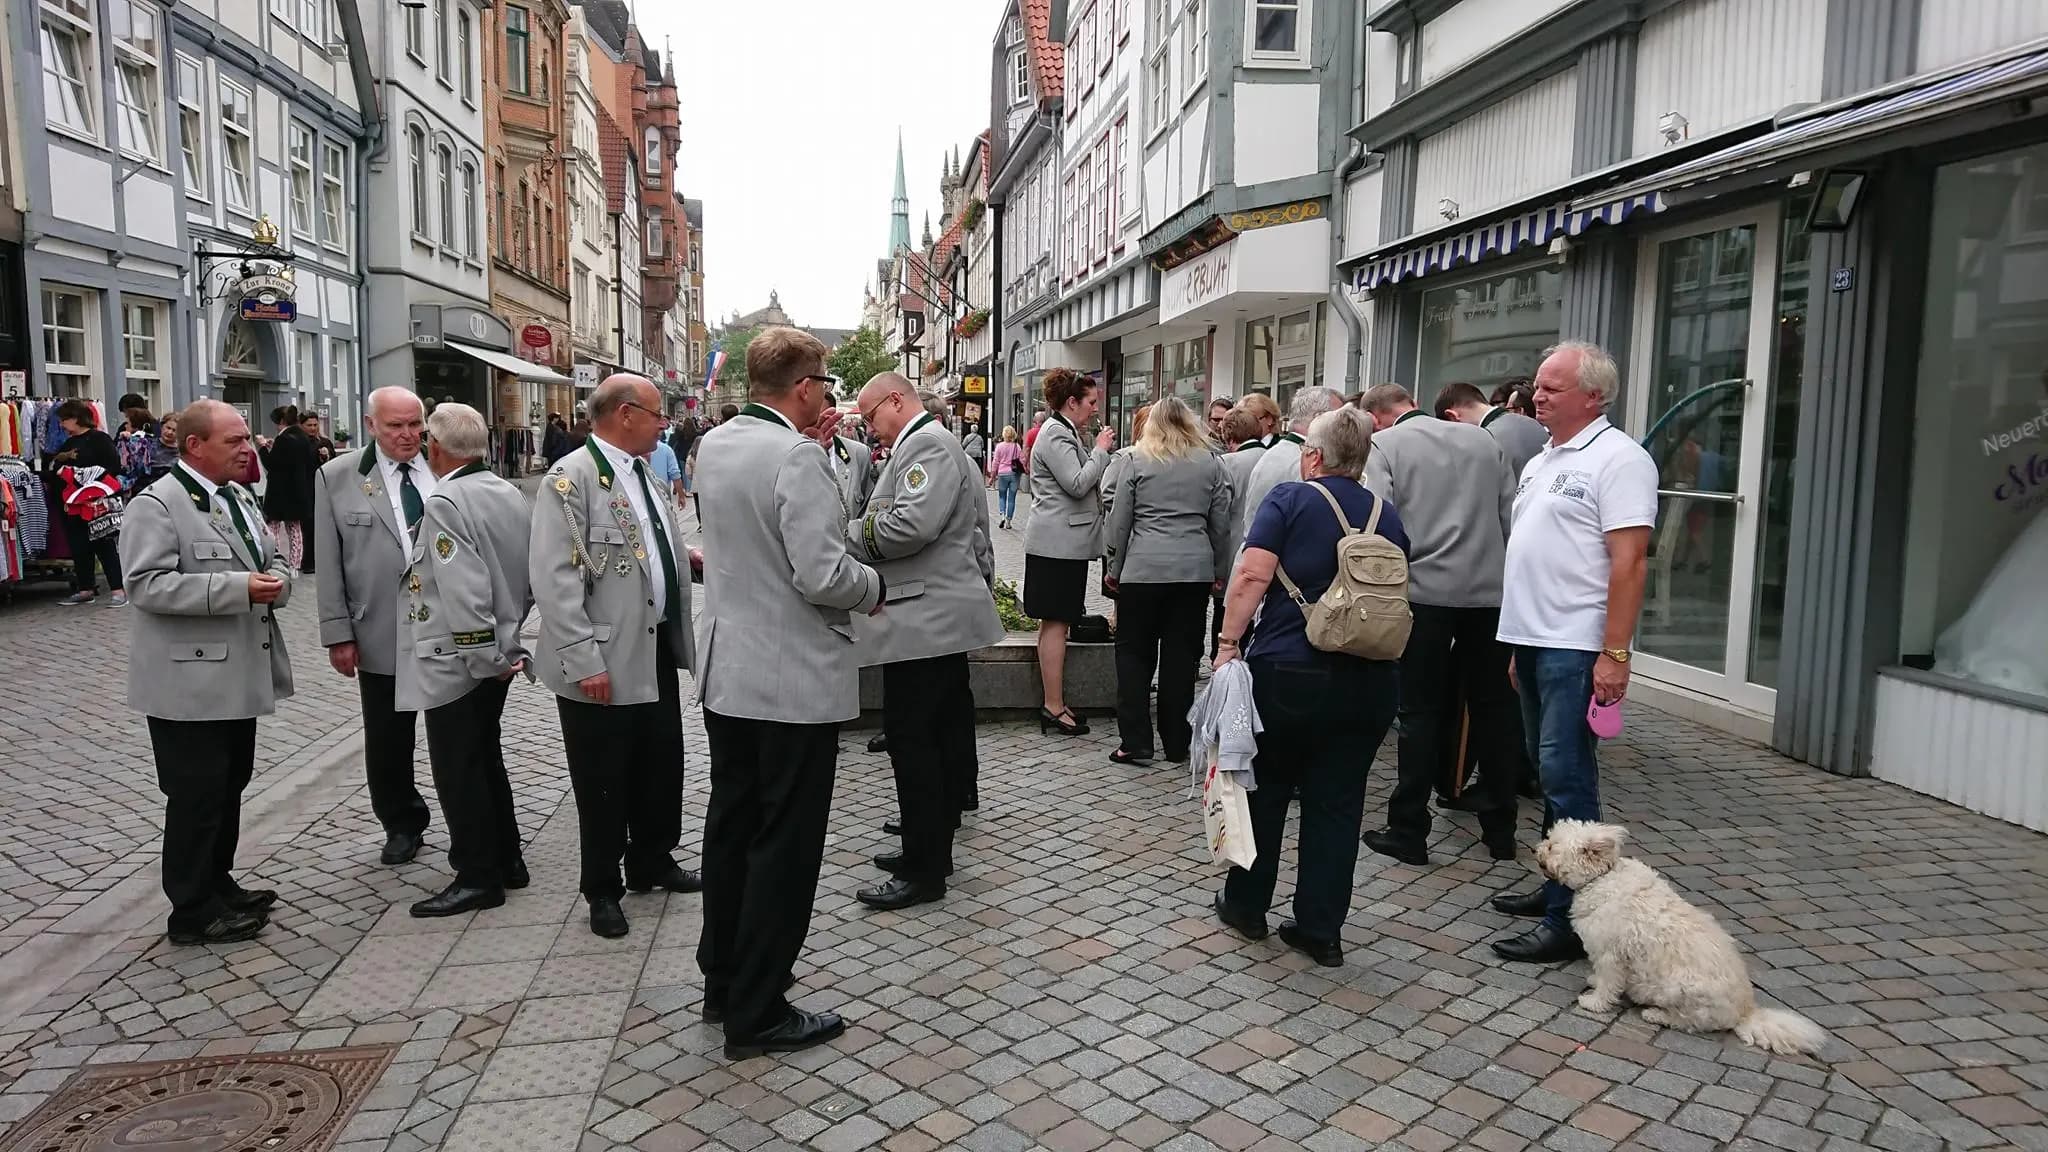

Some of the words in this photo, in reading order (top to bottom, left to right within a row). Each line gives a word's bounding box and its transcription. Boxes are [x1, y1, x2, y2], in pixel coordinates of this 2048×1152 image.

[244, 279, 260, 289] Zur
[264, 276, 291, 291] Krone
[1835, 270, 1850, 287] 23
[9, 385, 18, 397] 5
